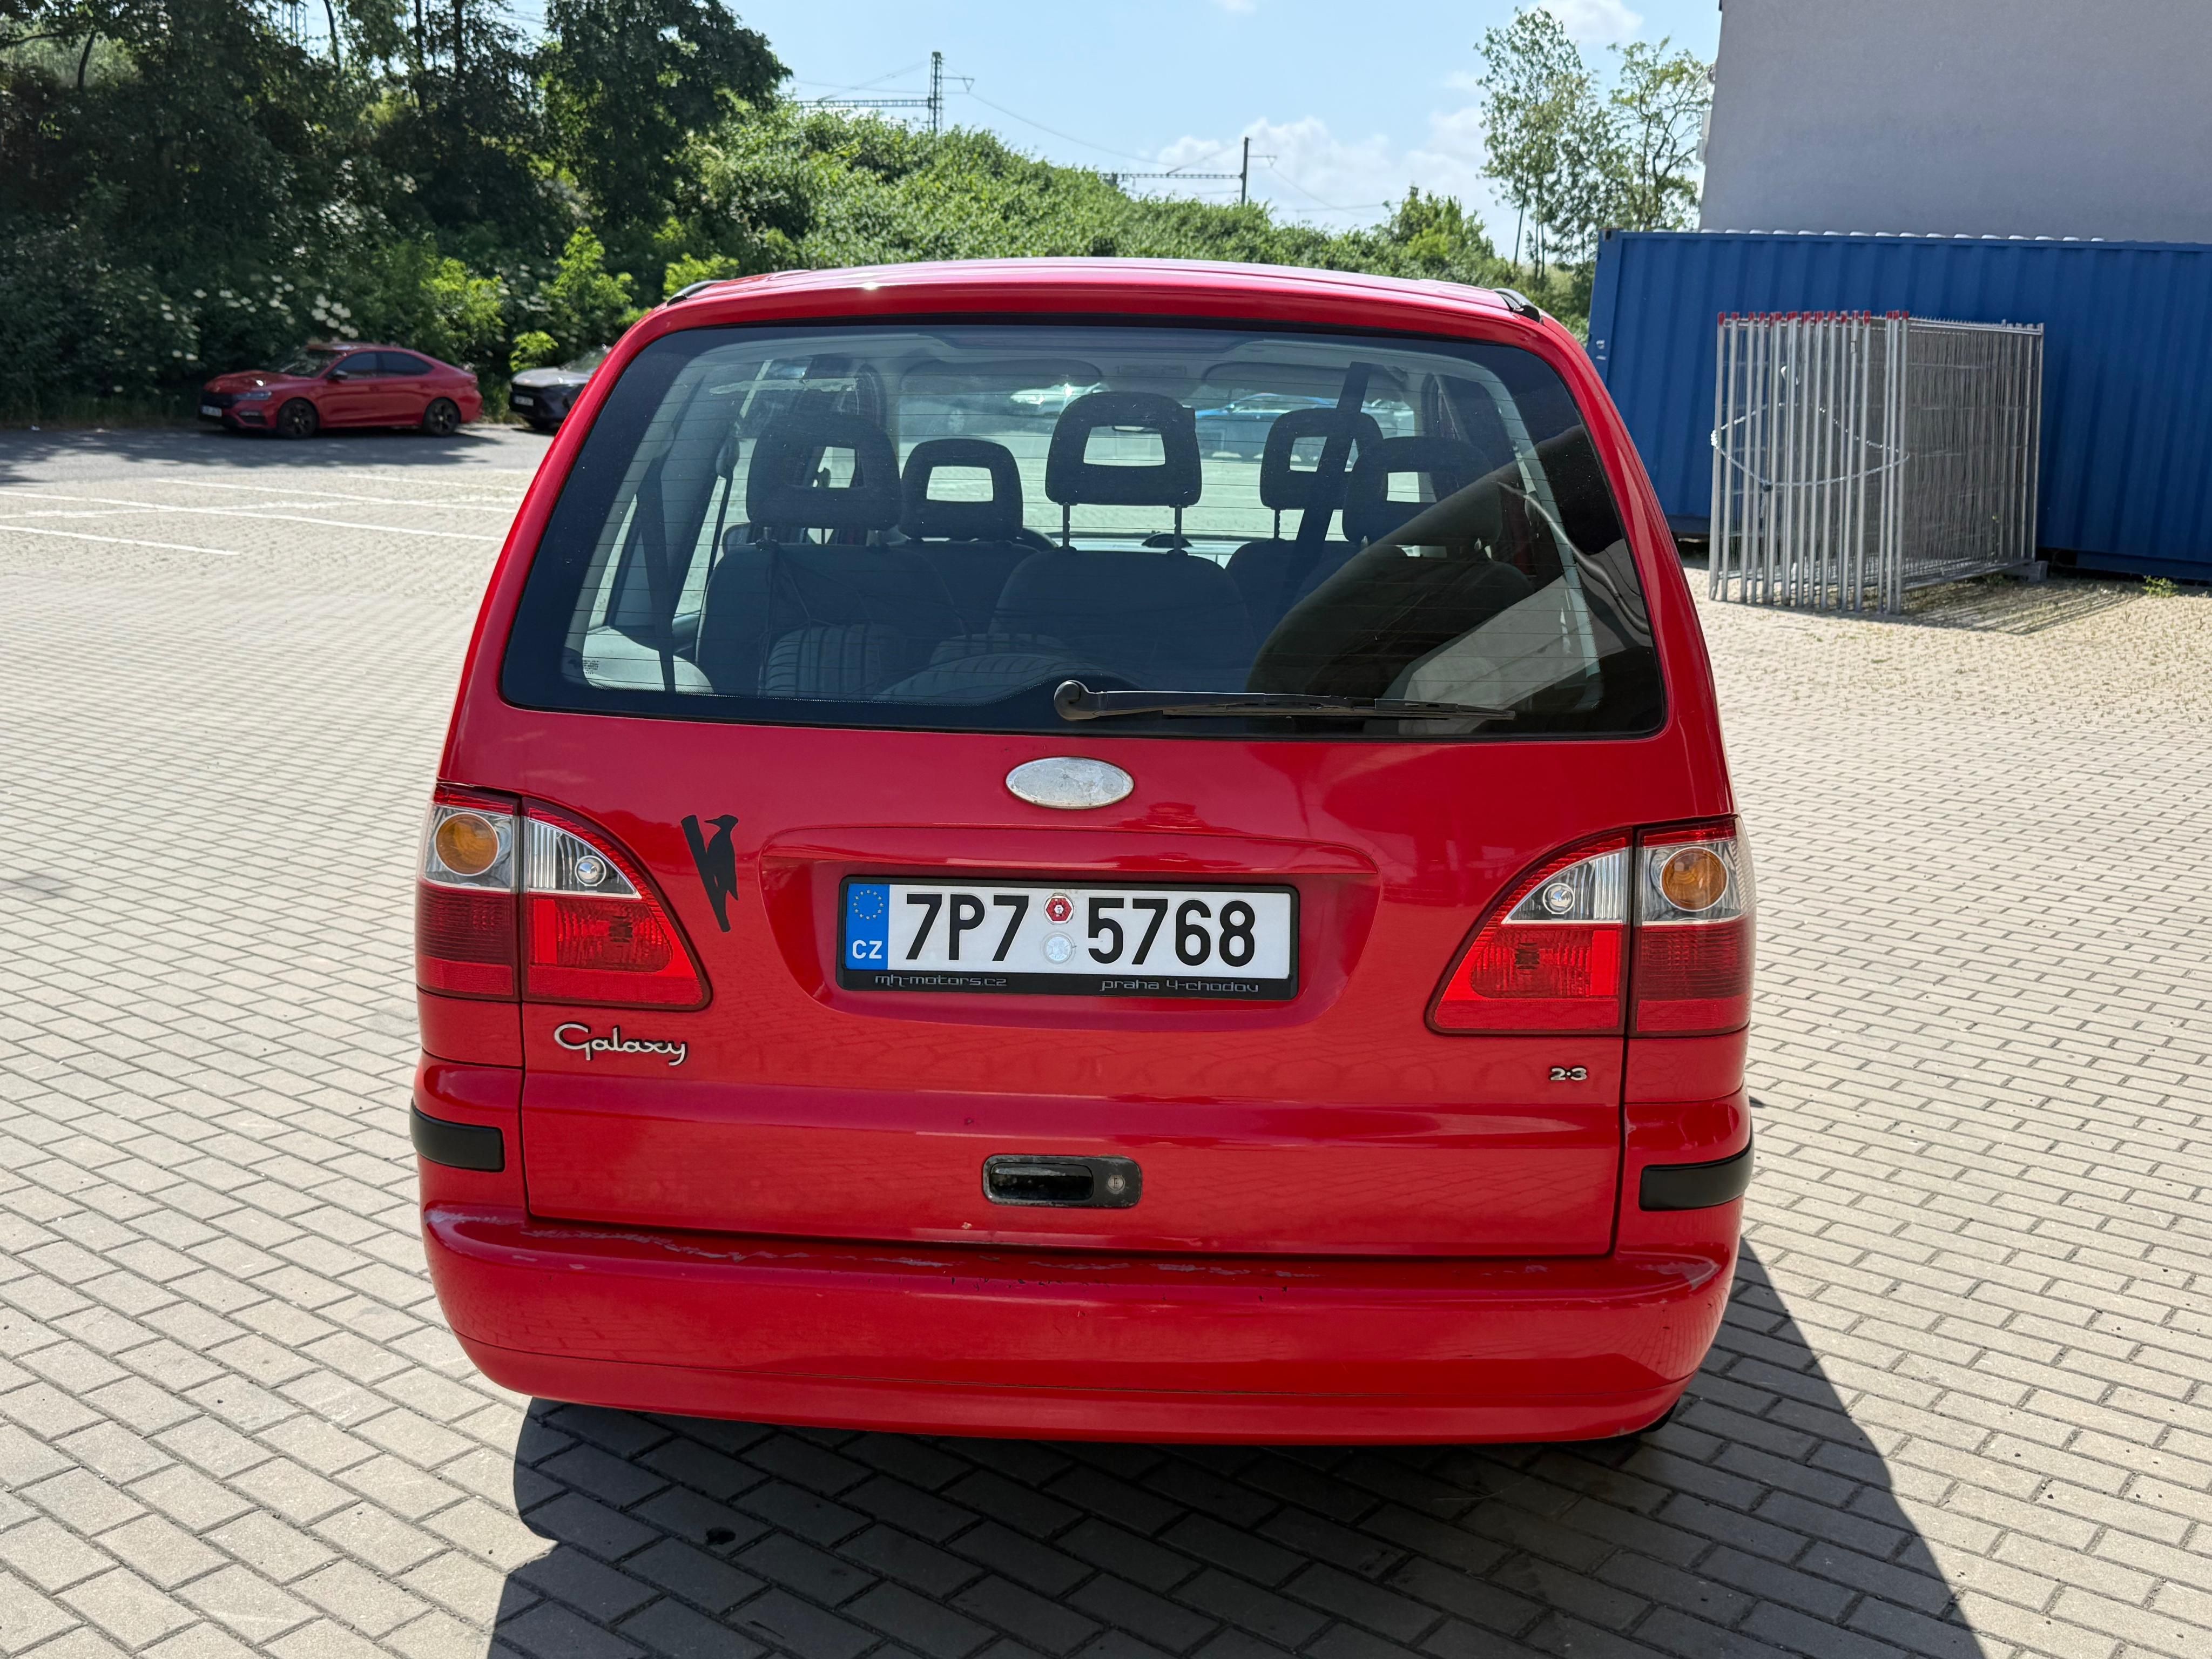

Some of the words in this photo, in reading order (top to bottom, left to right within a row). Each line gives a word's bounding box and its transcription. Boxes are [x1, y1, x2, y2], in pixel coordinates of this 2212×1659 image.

[906, 893, 1029, 961] 7P7
[1088, 897, 1256, 967] 5768
[852, 939, 882, 959] CZ
[875, 974, 1007, 987] mh-motors.cz
[1099, 979, 1159, 992] praha
[1166, 979, 1259, 993] 4-chodov
[554, 1022, 686, 1066] Galaxy
